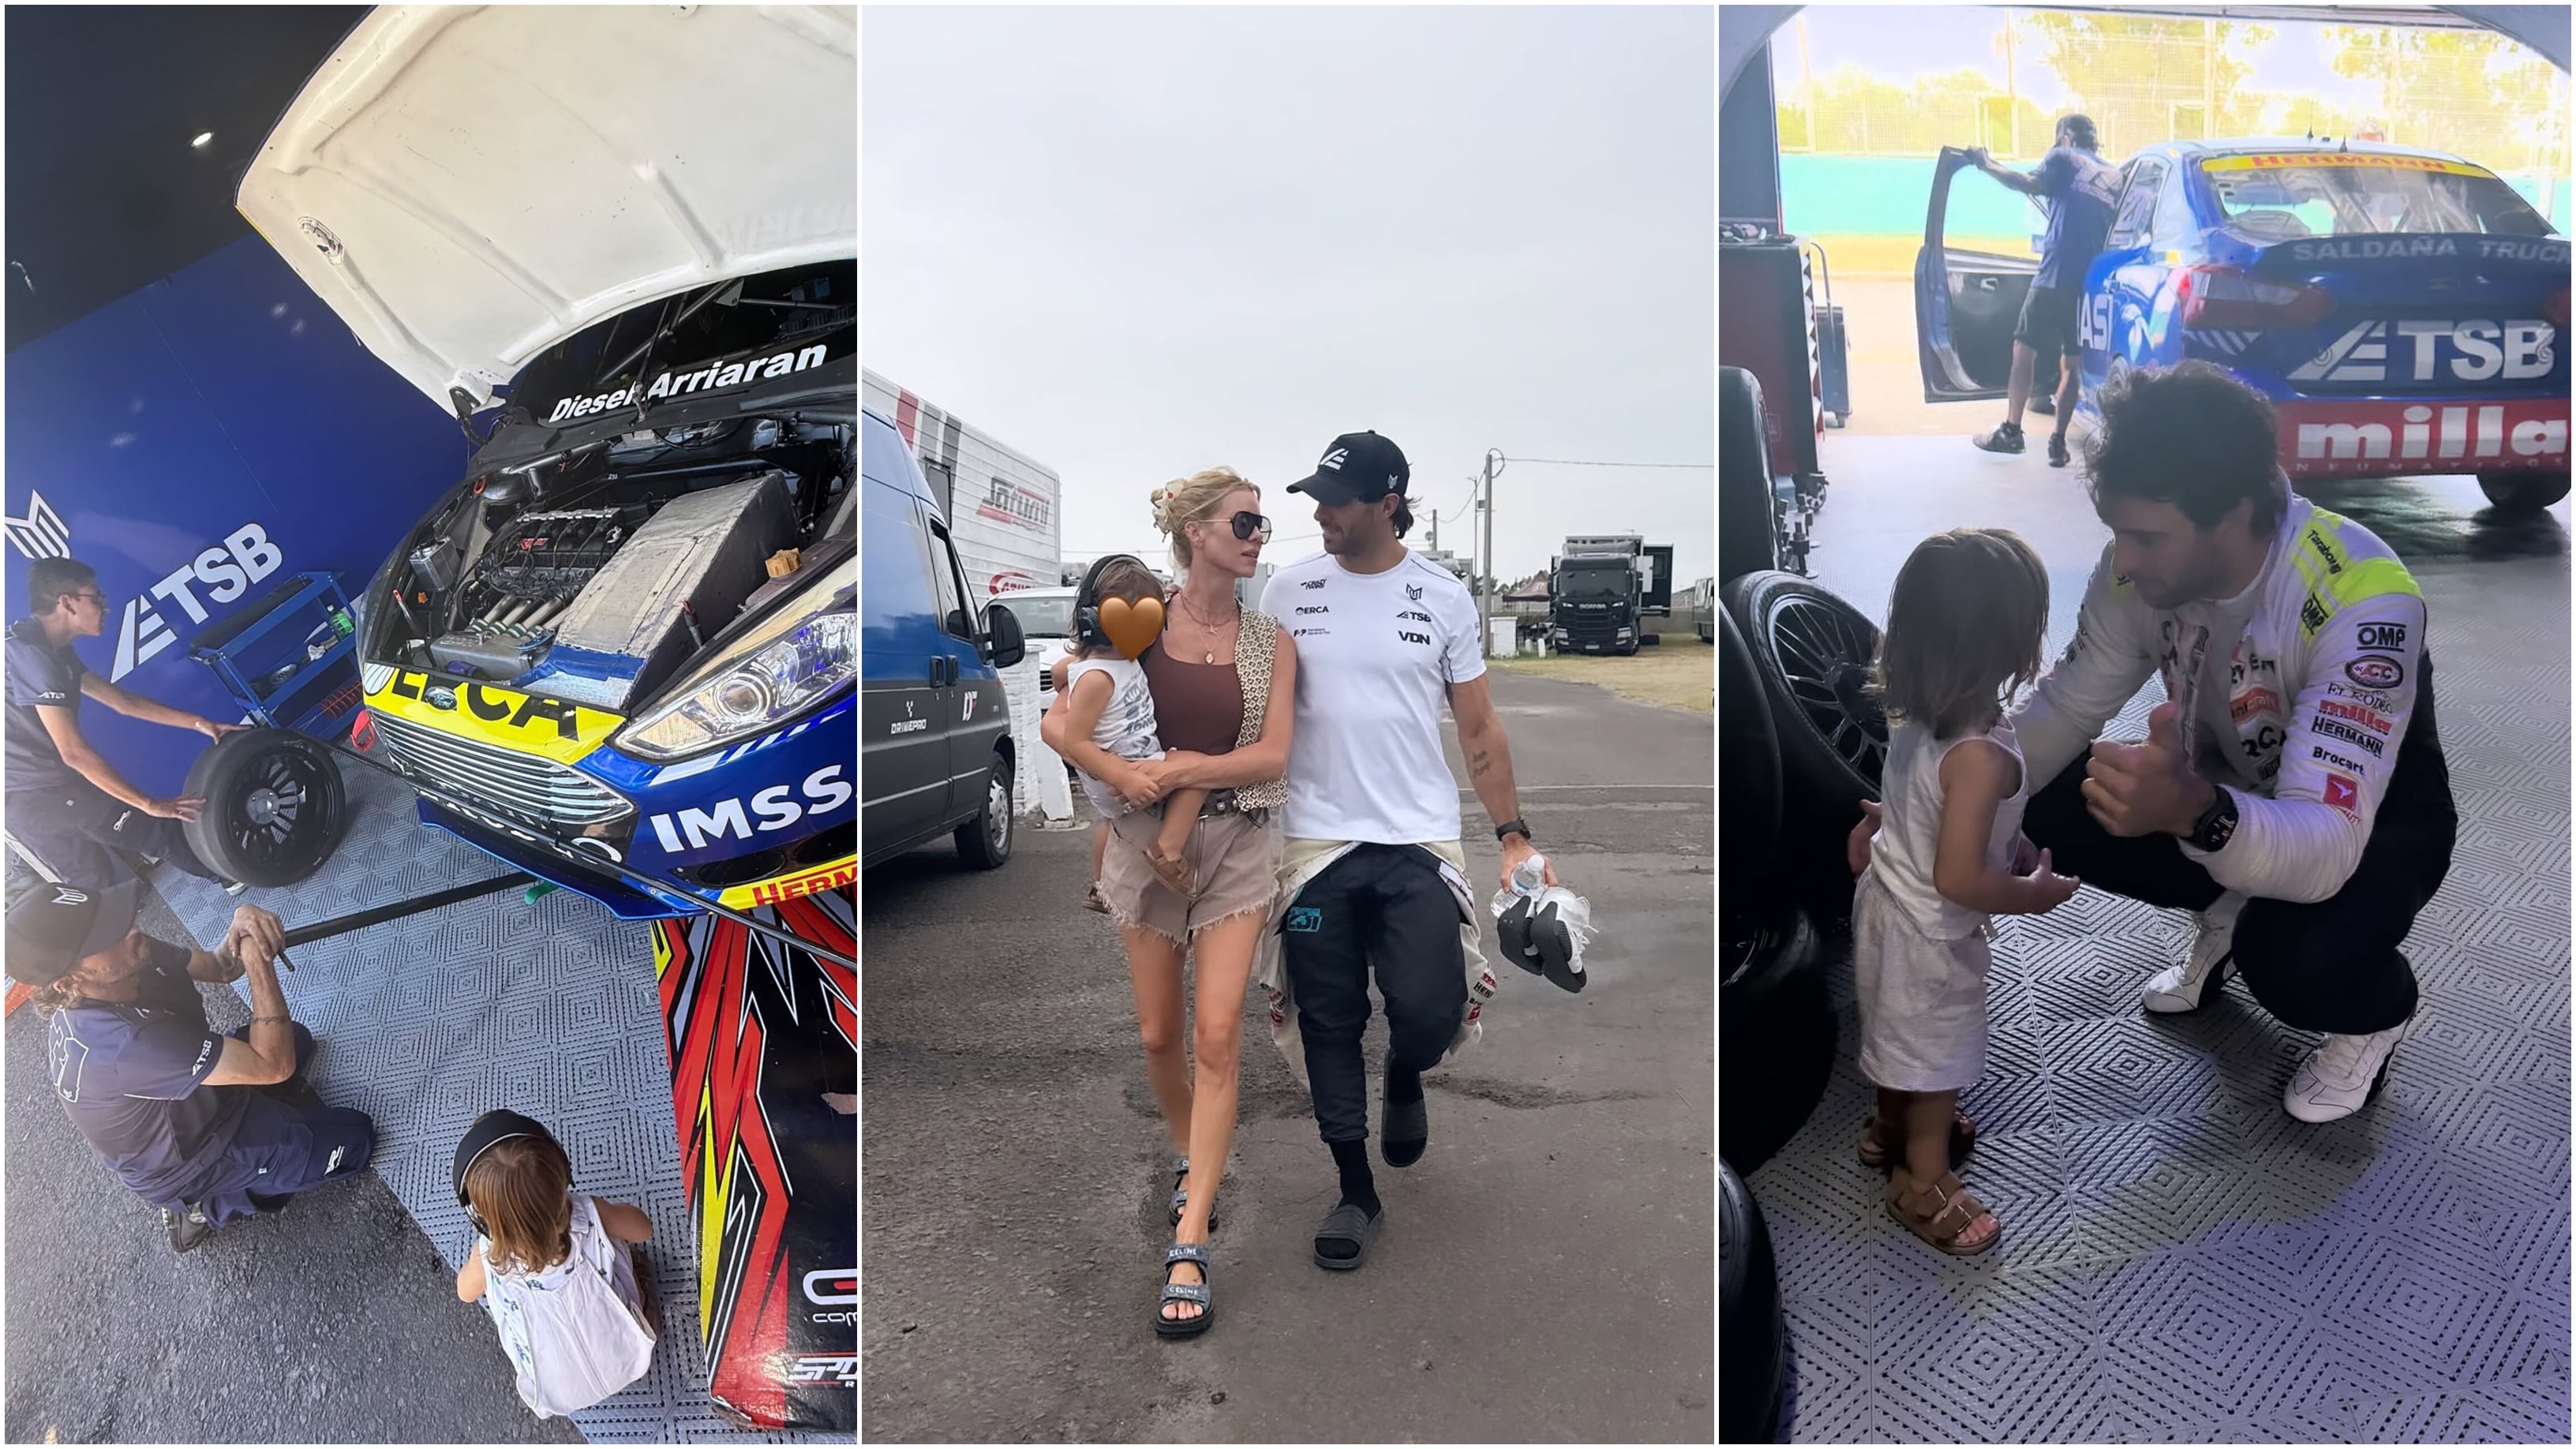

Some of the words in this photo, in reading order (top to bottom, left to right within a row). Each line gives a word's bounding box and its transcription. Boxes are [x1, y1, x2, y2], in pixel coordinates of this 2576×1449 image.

[2252, 155, 2445, 170] HERMANN
[2293, 237, 2458, 261] SALDAÑA
[2398, 320, 2555, 380] TSB
[646, 343, 827, 399] Arriaran
[2297, 405, 2568, 459] milla
[150, 522, 283, 625] TSB
[1410, 611, 1432, 622] TSB
[2301, 597, 2325, 629] OMP
[1398, 631, 1430, 645] VDN
[2357, 626, 2405, 647] OMP
[433, 693, 454, 710] Ford
[2311, 715, 2384, 758] HERMANN
[2312, 746, 2365, 776] Brocart
[650, 764, 857, 853] IMSS
[1169, 1286, 1199, 1295] CELINE
